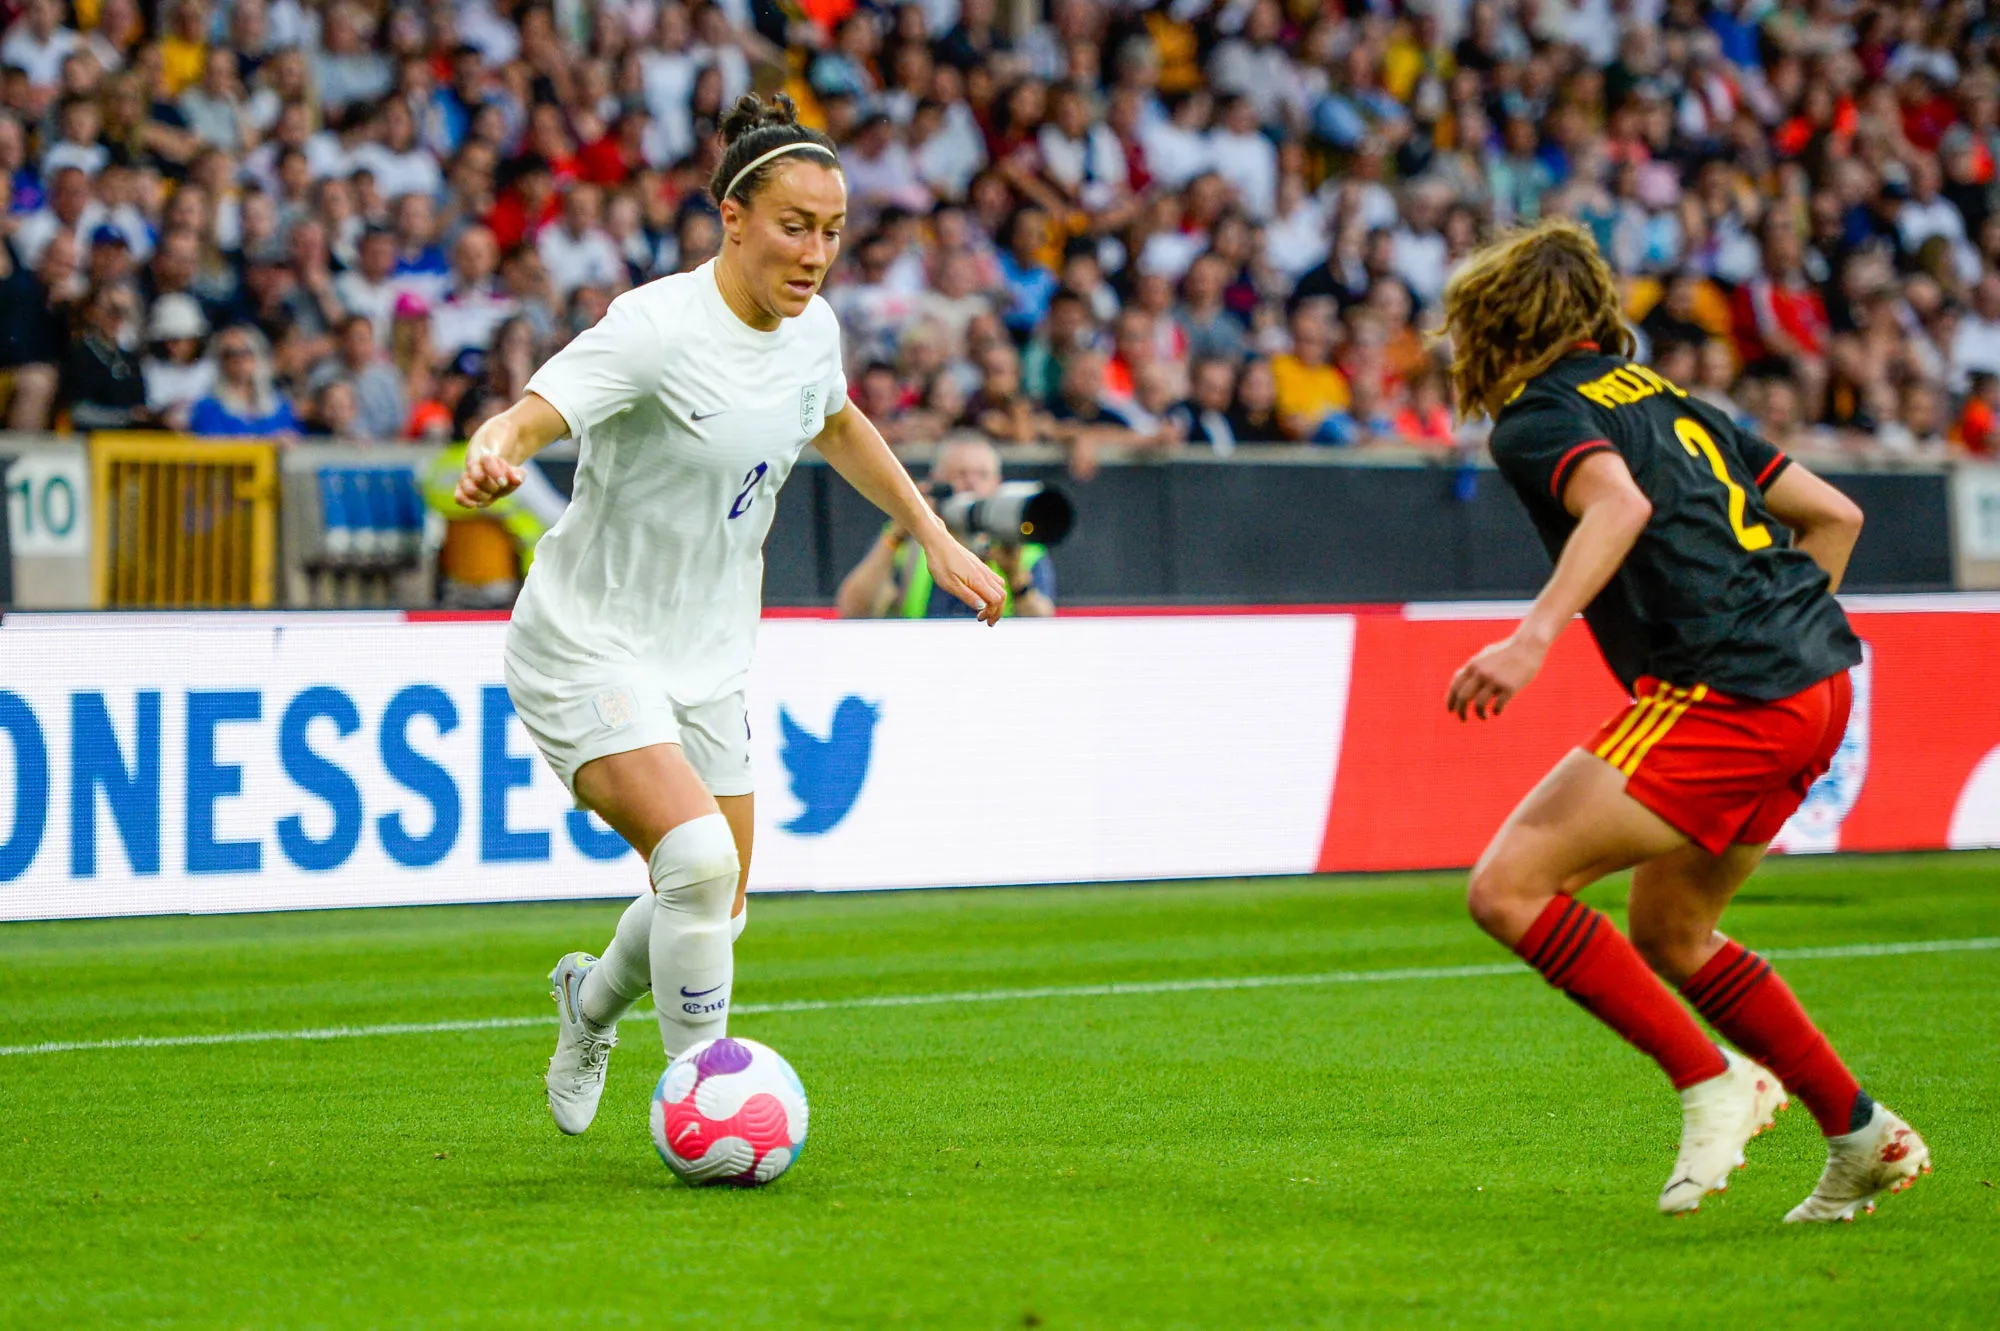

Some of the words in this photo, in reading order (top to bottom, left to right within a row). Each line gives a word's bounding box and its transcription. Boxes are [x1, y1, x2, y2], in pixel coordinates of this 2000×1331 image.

[7, 476, 76, 537] 10
[728, 461, 768, 519] 2
[1674, 417, 1772, 551] 2
